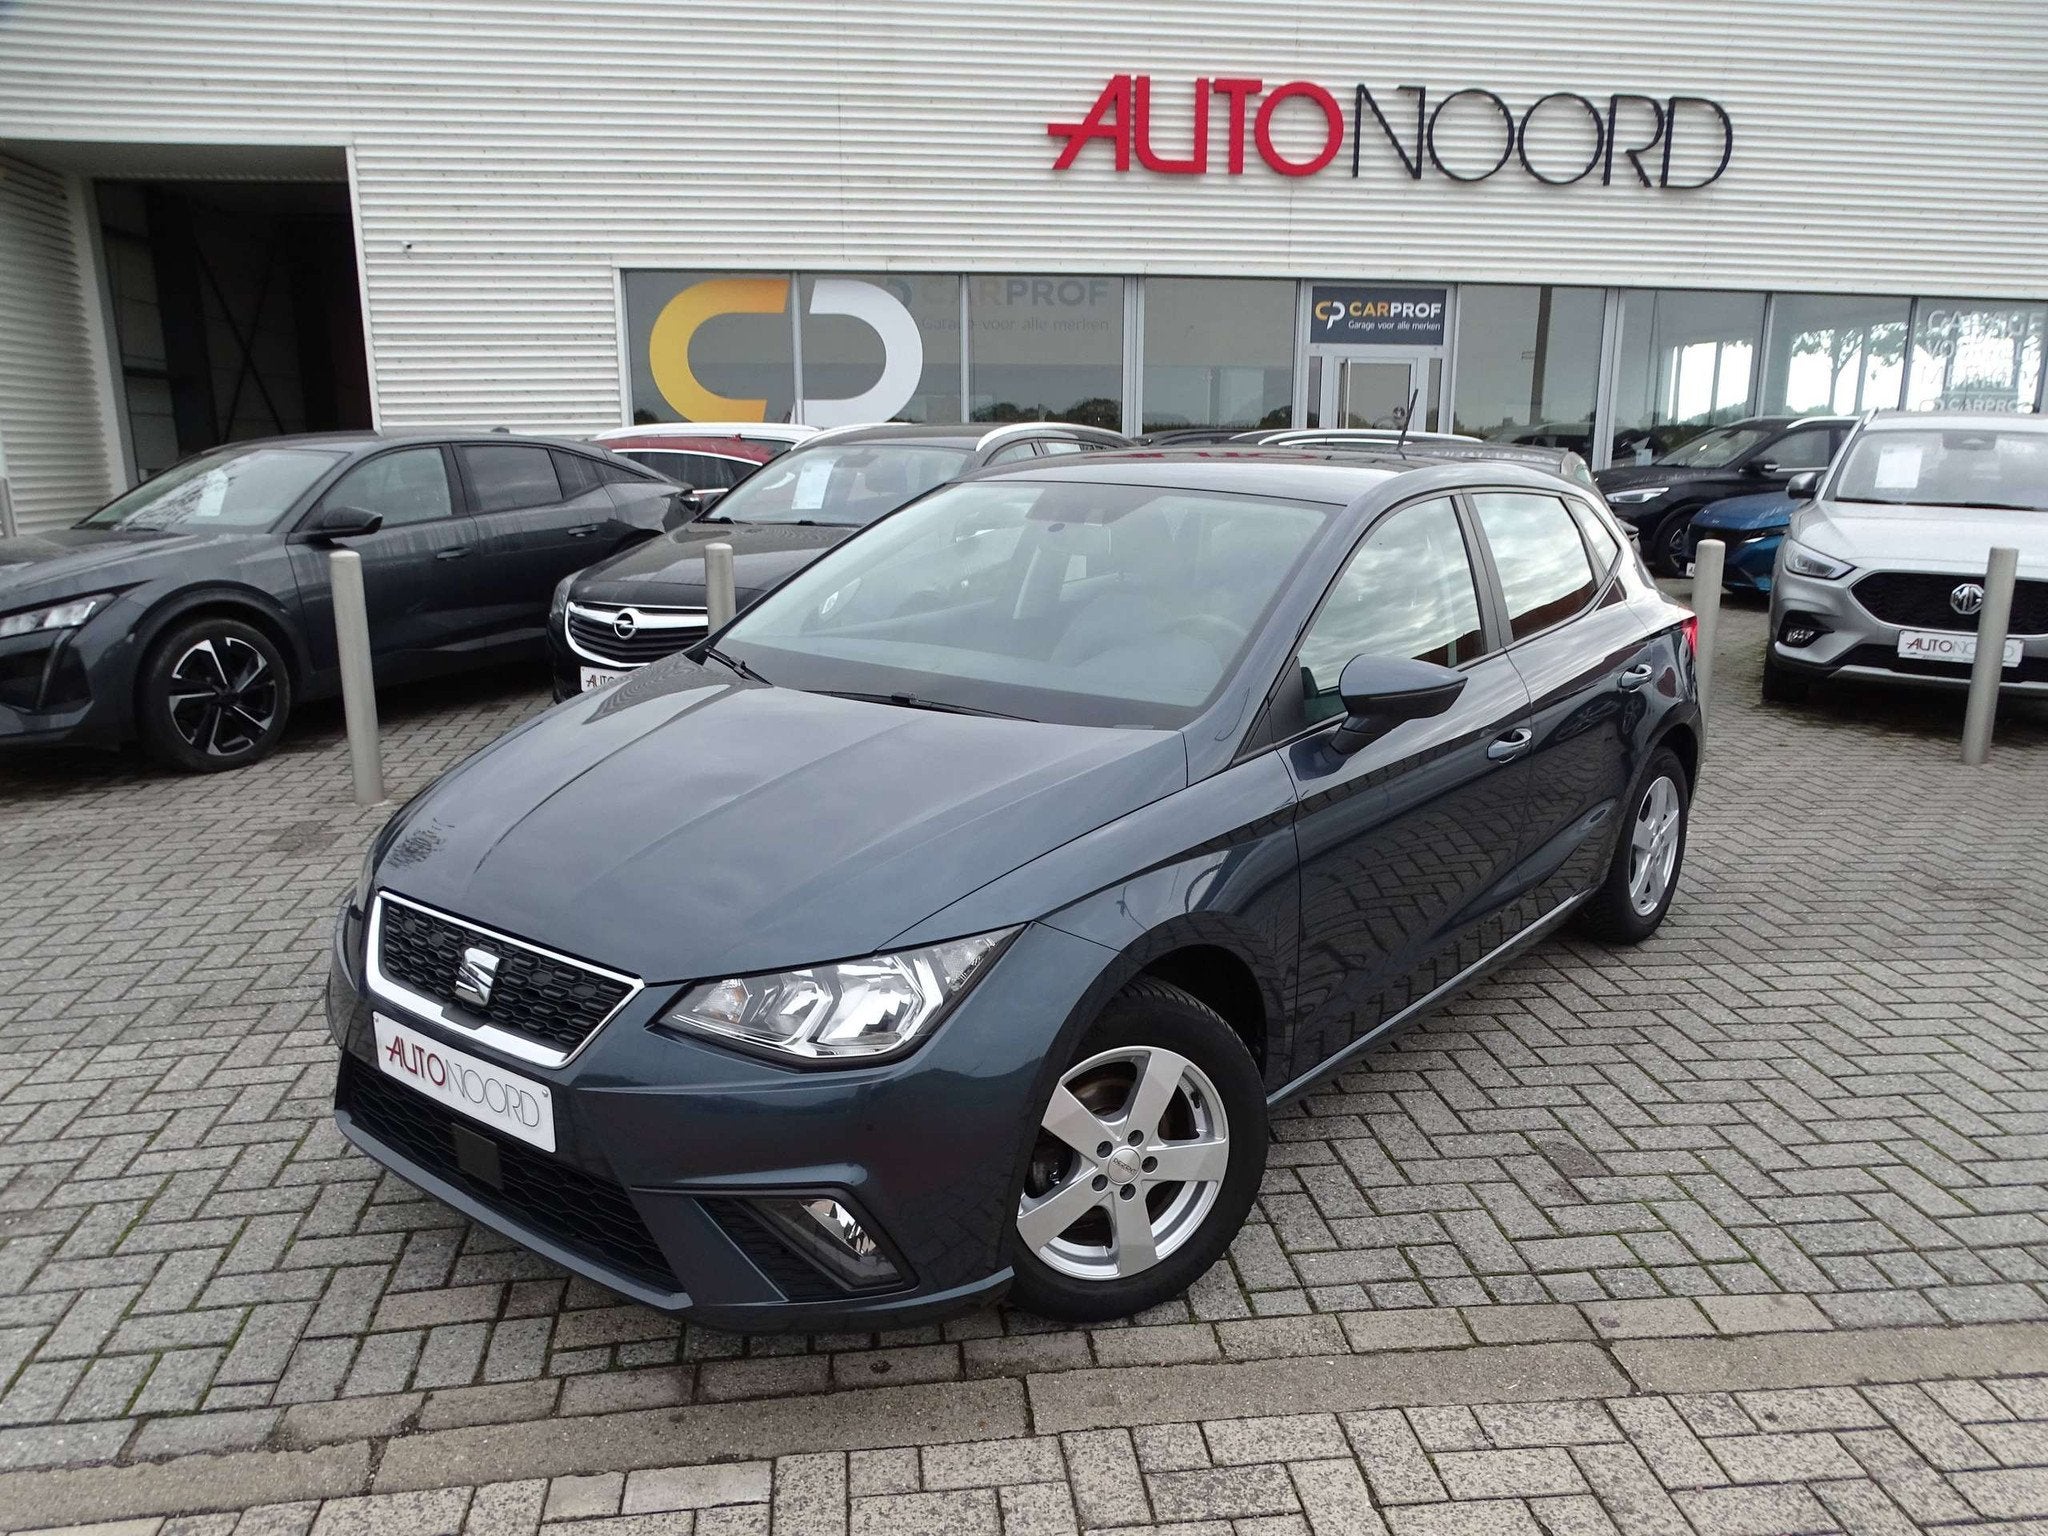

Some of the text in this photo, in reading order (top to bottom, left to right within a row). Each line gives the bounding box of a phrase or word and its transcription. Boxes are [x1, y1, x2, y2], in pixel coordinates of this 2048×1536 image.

[1048, 74, 1733, 189] AUTONOORD
[1348, 321, 1440, 332] Garage voor alle merken
[1349, 301, 1442, 318] CARPROF
[386, 1036, 540, 1128] AUTONOORD
